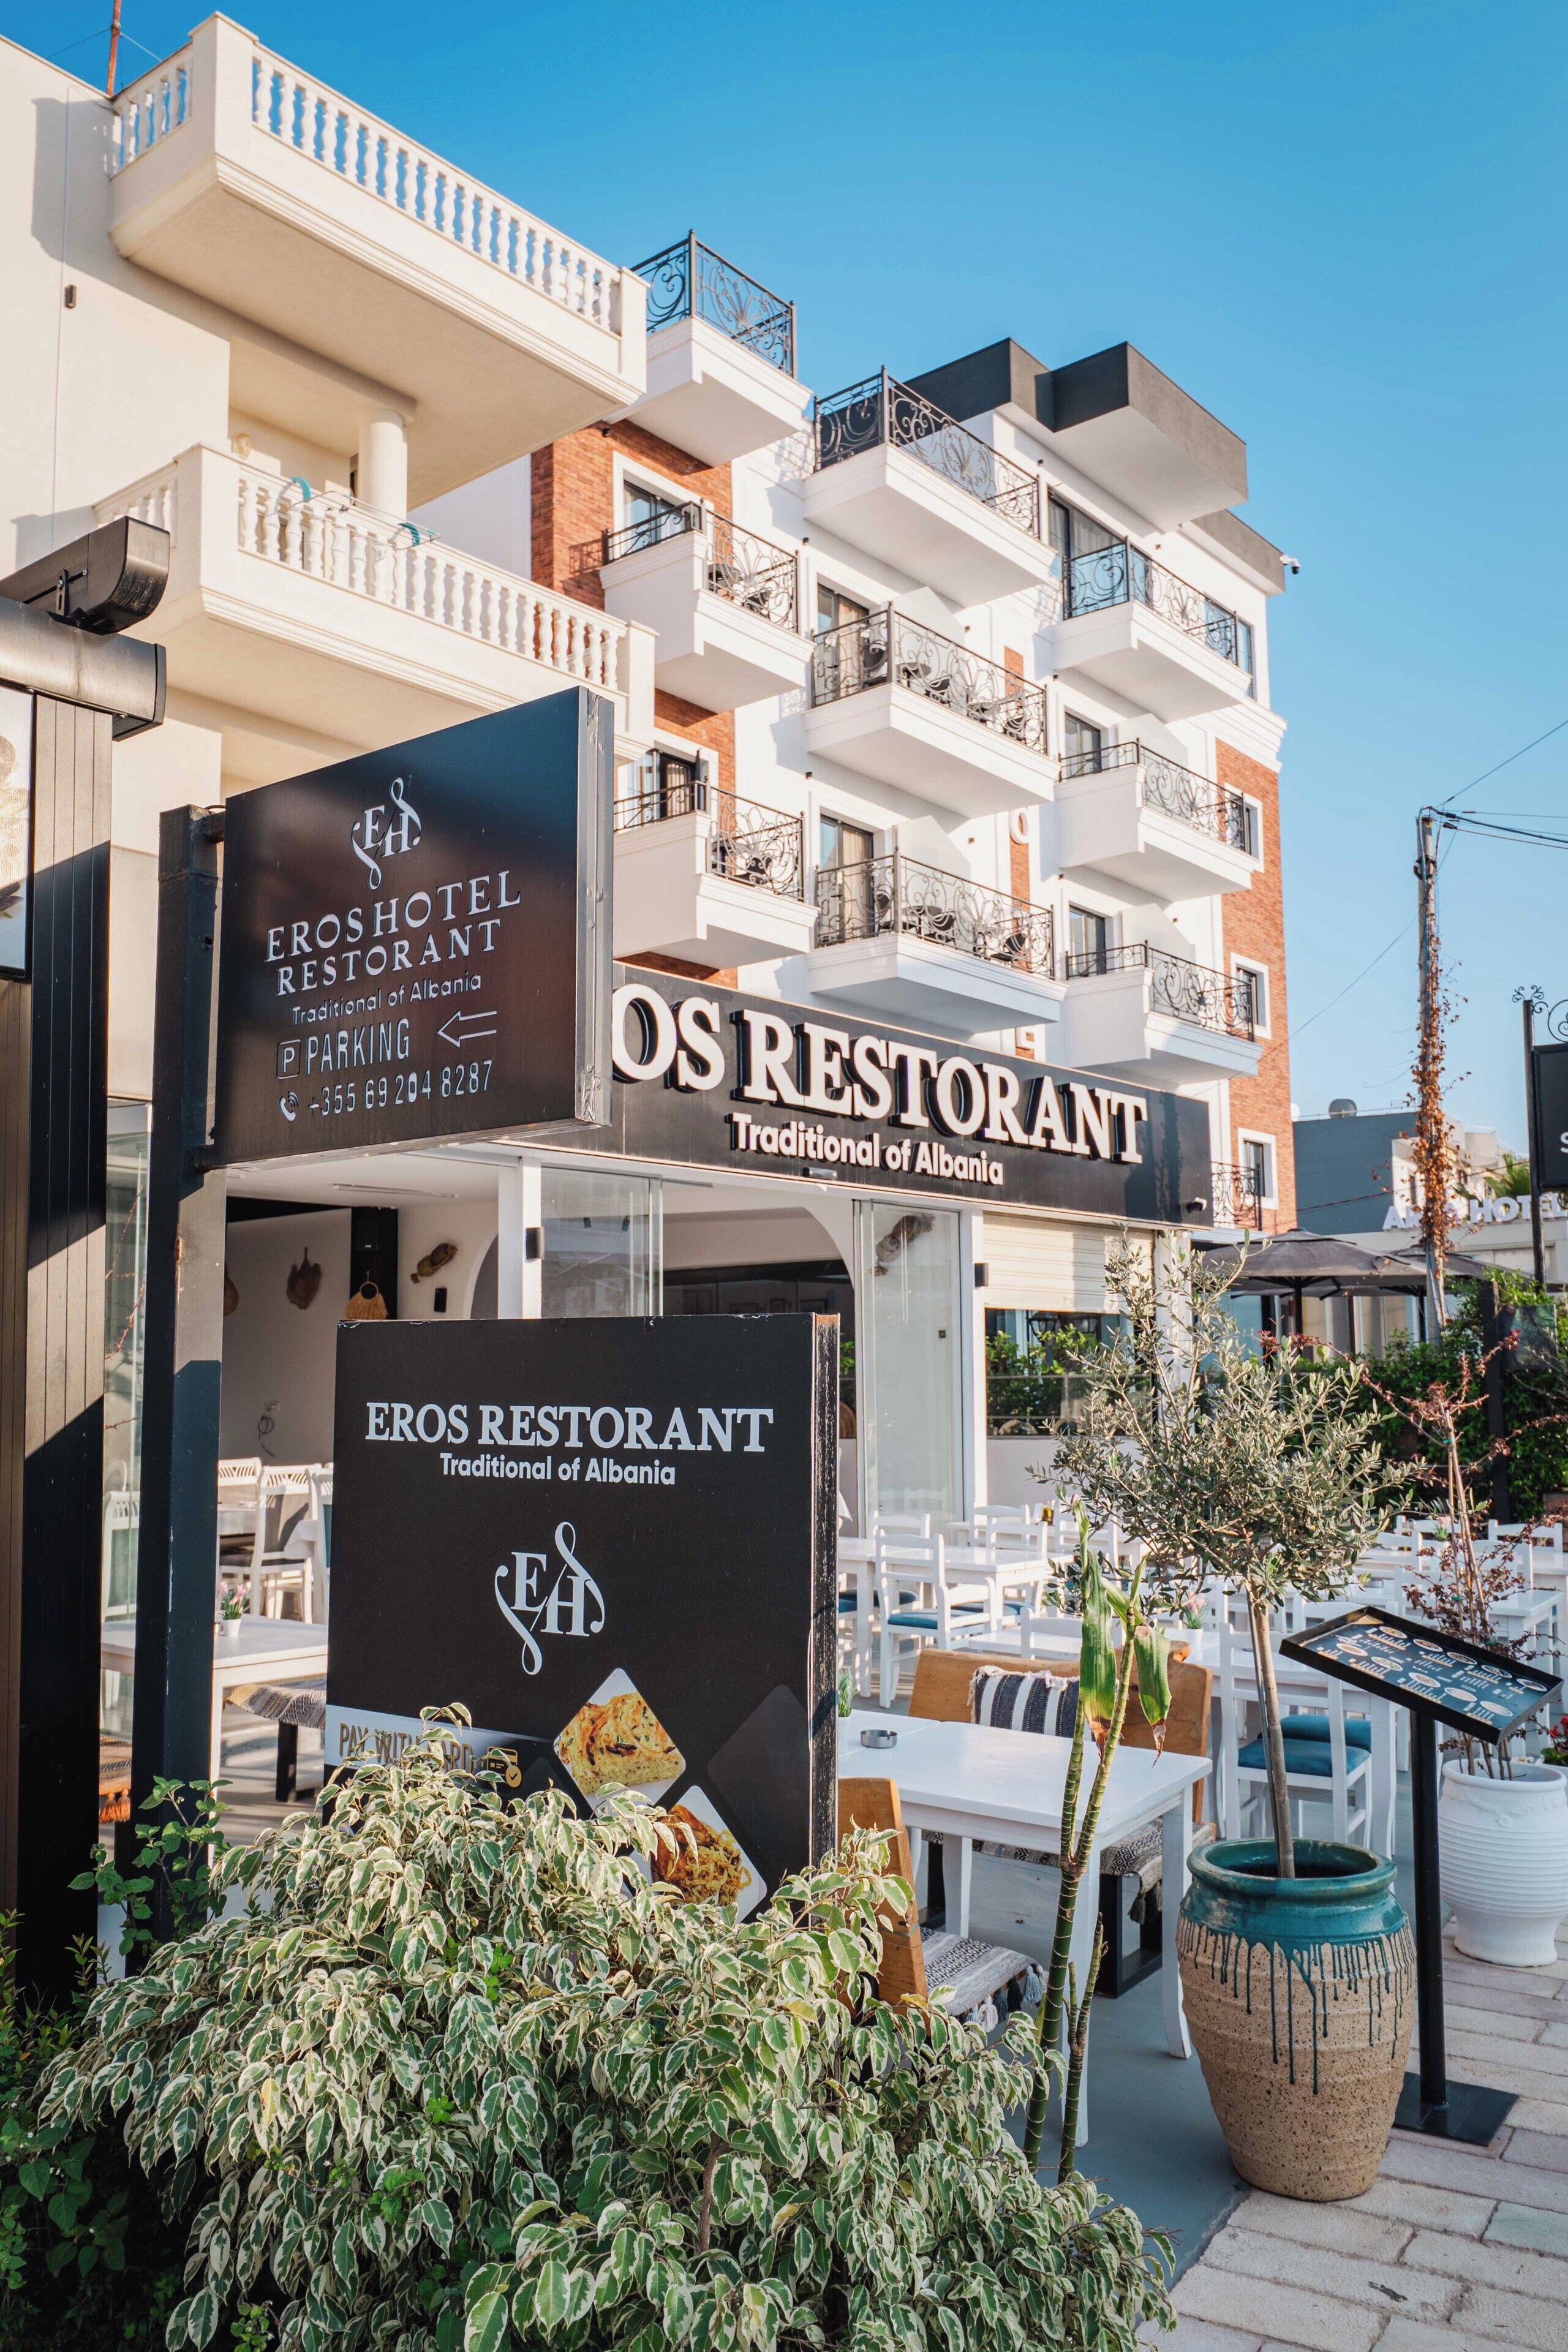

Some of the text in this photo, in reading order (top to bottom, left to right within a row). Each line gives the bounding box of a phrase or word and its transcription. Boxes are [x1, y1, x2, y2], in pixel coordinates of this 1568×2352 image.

[276, 919, 501, 997] RESTORANT
[291, 971, 481, 1025] Traditional of Albania
[307, 1018, 410, 1074] PARKING
[308, 1060, 492, 1116] +355 69 204 8287
[741, 1009, 1148, 1164] RESTORANT
[732, 1112, 1004, 1185] Traditional of Albania
[1469, 1192, 1567, 1224] HOTEL
[365, 1402, 774, 1452] EROS RESTORANT
[440, 1452, 676, 1485] Traditional of Albania
[426, 1737, 473, 1774] ARD
